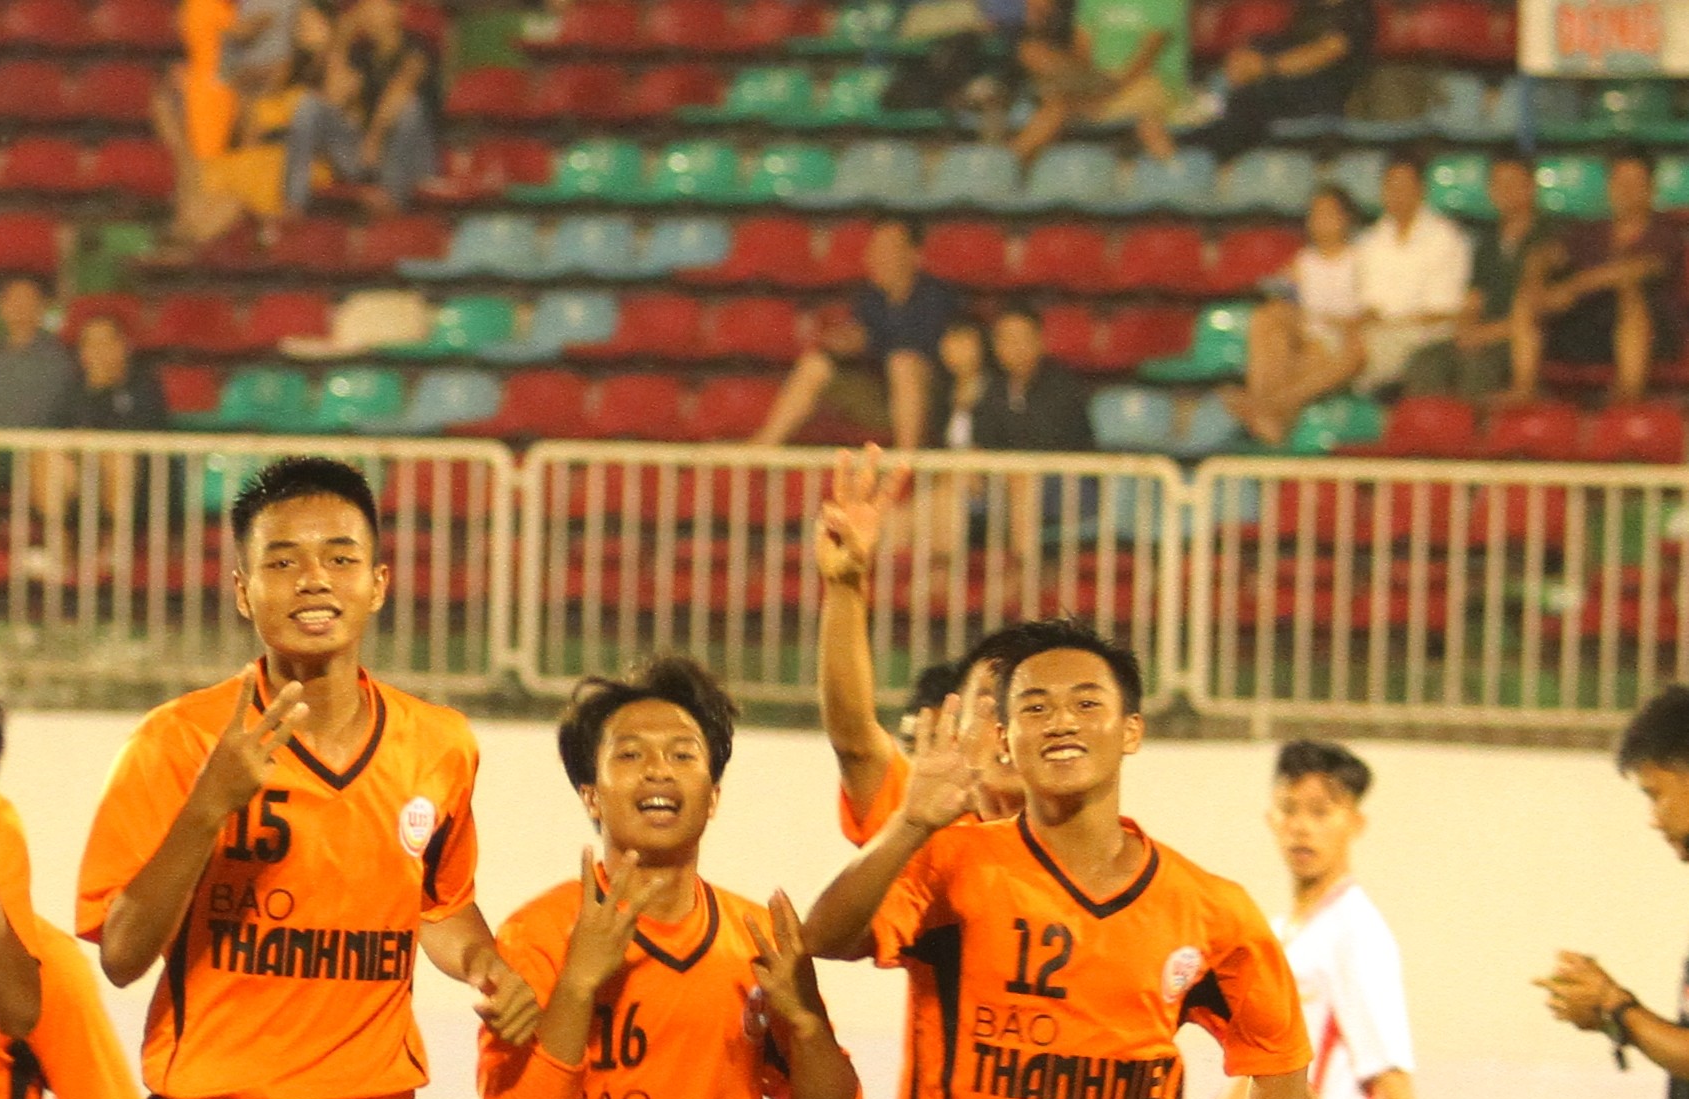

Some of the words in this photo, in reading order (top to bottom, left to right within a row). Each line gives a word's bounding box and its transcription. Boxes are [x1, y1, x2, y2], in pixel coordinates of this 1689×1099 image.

[224, 789, 291, 864] 15
[1005, 916, 1073, 1000] 12
[590, 1000, 648, 1070] 16
